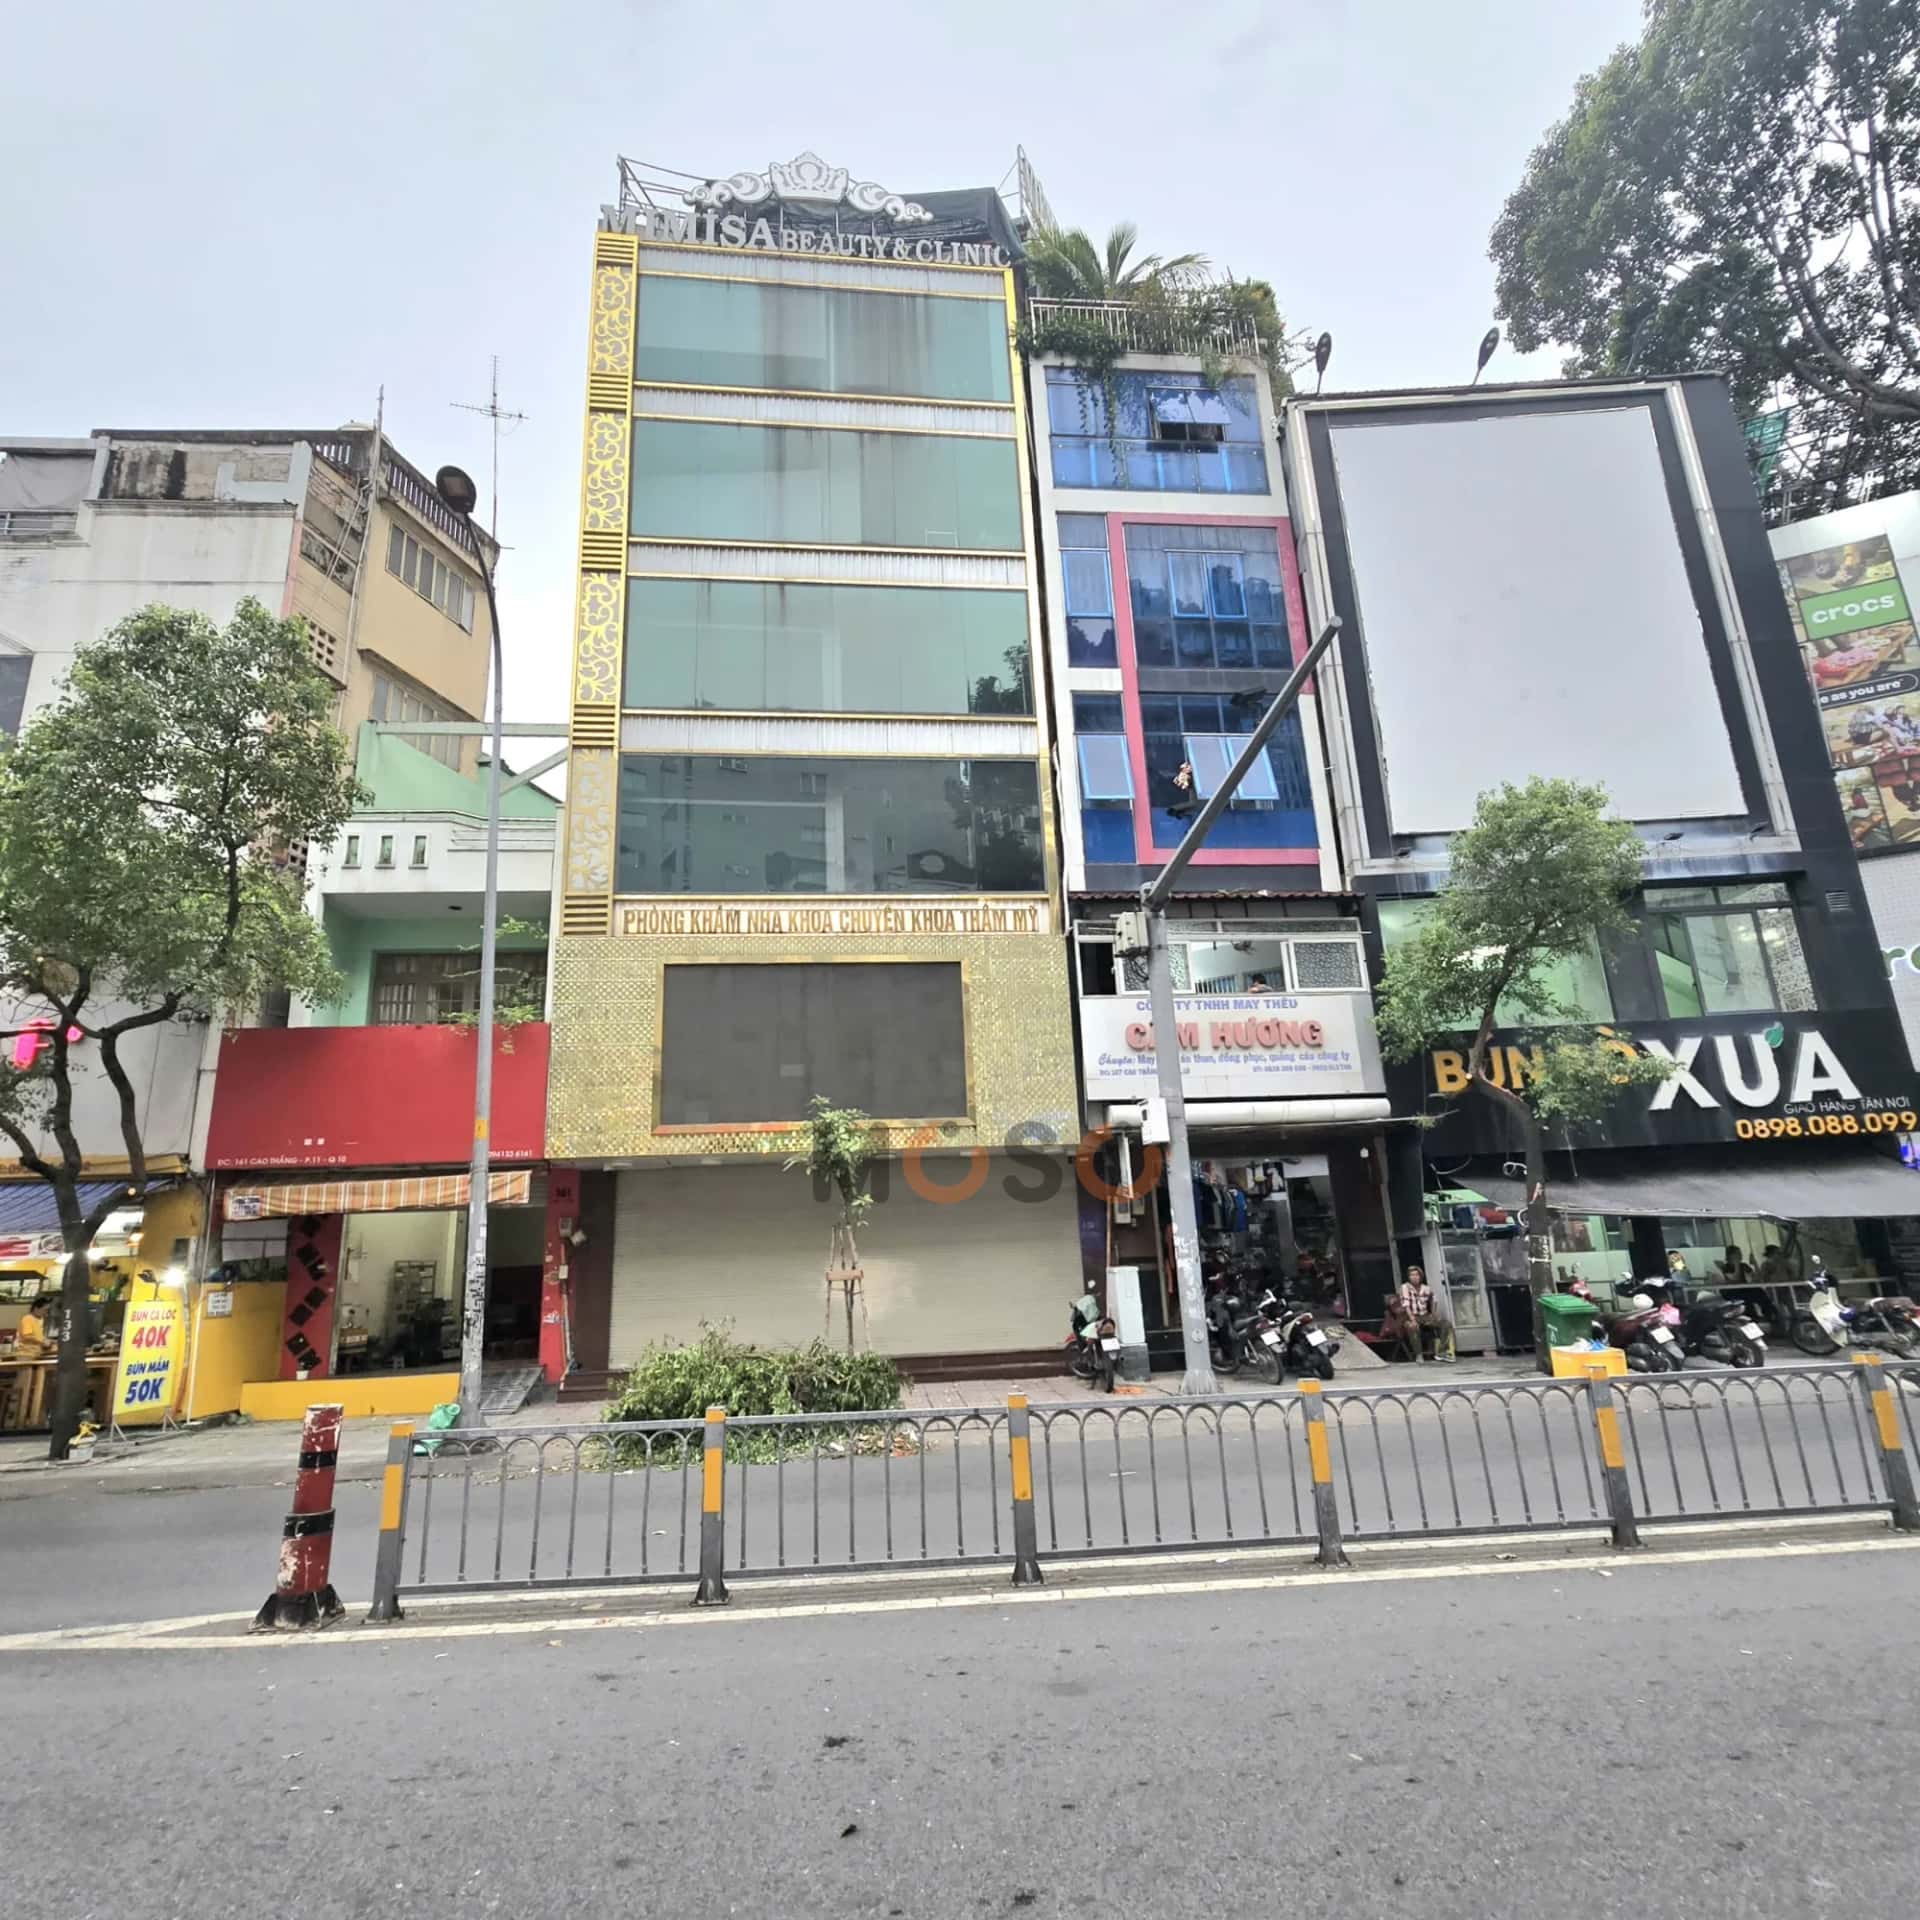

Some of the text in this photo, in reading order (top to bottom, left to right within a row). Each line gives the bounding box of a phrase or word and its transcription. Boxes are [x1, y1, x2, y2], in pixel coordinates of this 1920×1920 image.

[599, 204, 778, 250] MIMISA
[1812, 595, 1895, 624] crocs
[1831, 692, 1848, 702] as
[1849, 686, 1874, 699] you
[623, 905, 685, 934] PHÒNG
[690, 905, 740, 934] KHÁM
[748, 909, 783, 934] NHA
[788, 909, 833, 934] KHOA
[839, 905, 904, 932] CHUYÊN
[911, 908, 956, 932] KHOA
[1176, 1001, 1191, 1010] TY
[1195, 1001, 1230, 1010] TNHH
[1233, 1000, 1260, 1010] MAY
[1211, 1016, 1324, 1050] HƯƠNG
[1638, 1022, 1862, 1111] XƯA
[1784, 1102, 1815, 1114] GIAO
[1819, 1097, 1856, 1112] HÀNG
[1735, 1111, 1917, 1139] 0898.088.099
[132, 1325, 170, 1349] 40K
[124, 1377, 164, 1405] 50K
